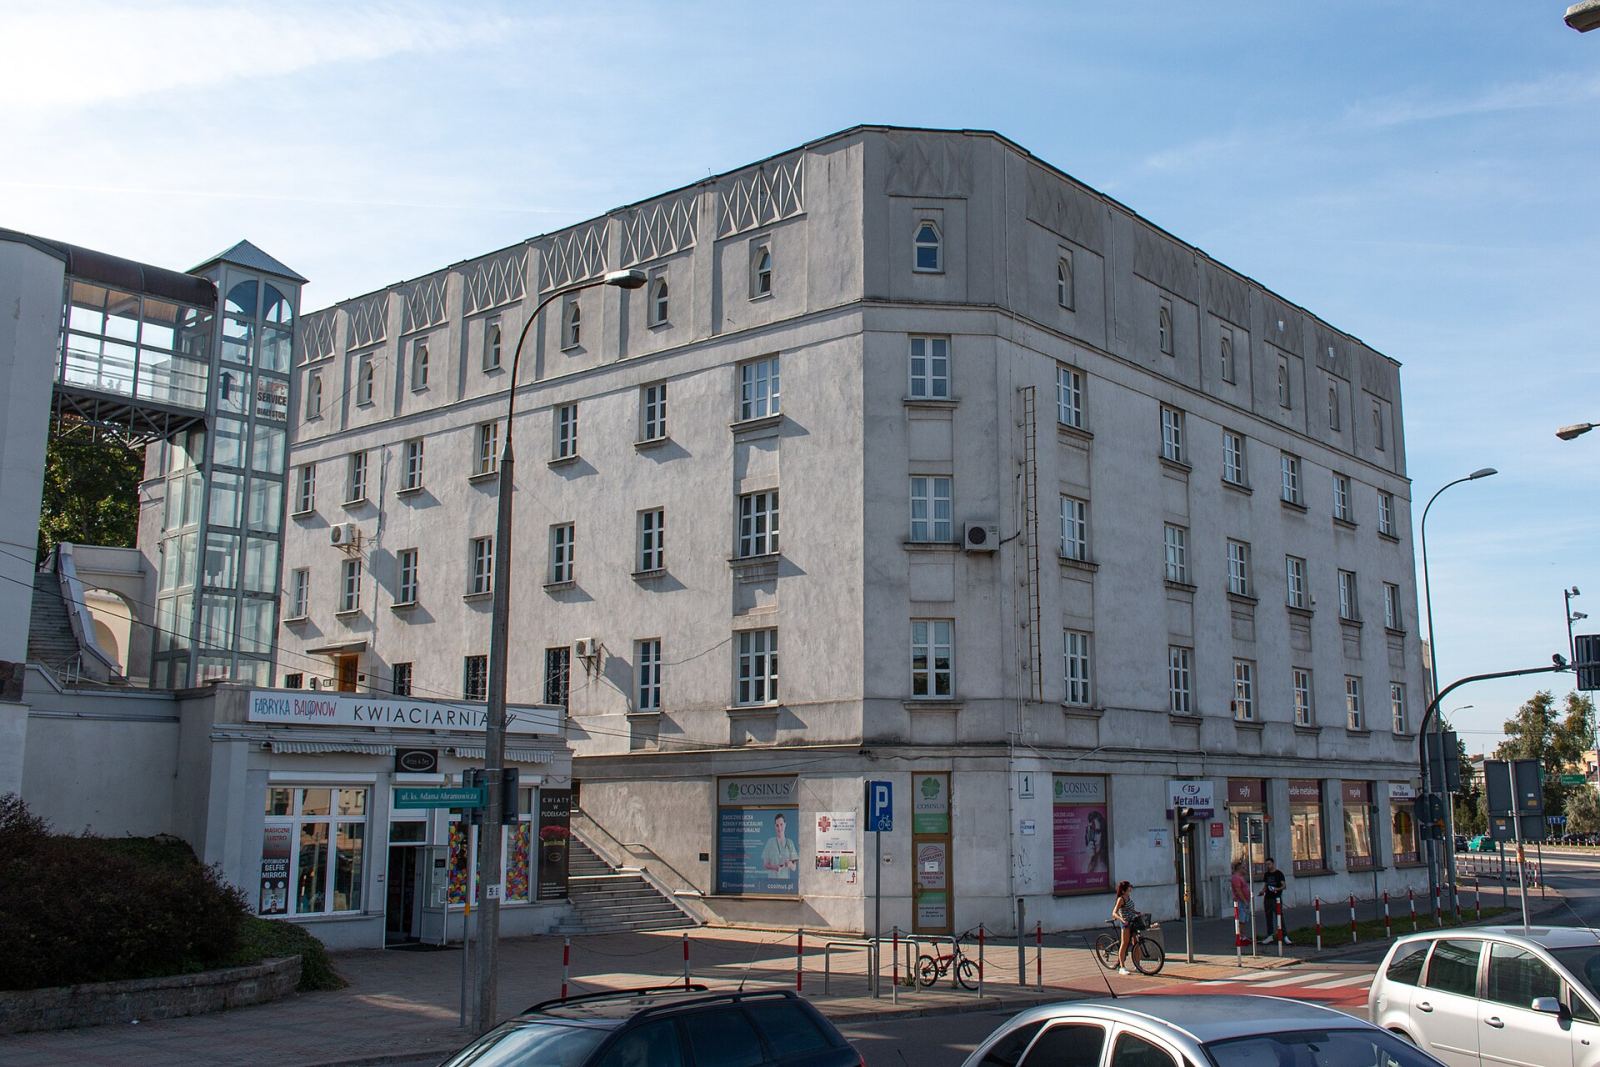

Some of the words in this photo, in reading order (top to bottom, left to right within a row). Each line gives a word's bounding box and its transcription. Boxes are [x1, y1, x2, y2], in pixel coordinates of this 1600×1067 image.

[257, 391, 287, 406] SERVICE
[254, 698, 290, 715] FABRYKA
[354, 705, 488, 727] KWIACIARNIA
[740, 783, 790, 795] COSINUS
[1023, 775, 1029, 792] 1
[1063, 782, 1098, 794] COSINUS
[420, 792, 439, 800] Adama
[875, 785, 888, 817] P
[1173, 795, 1209, 806] Metalkas
[261, 871, 287, 879] MIRROR
